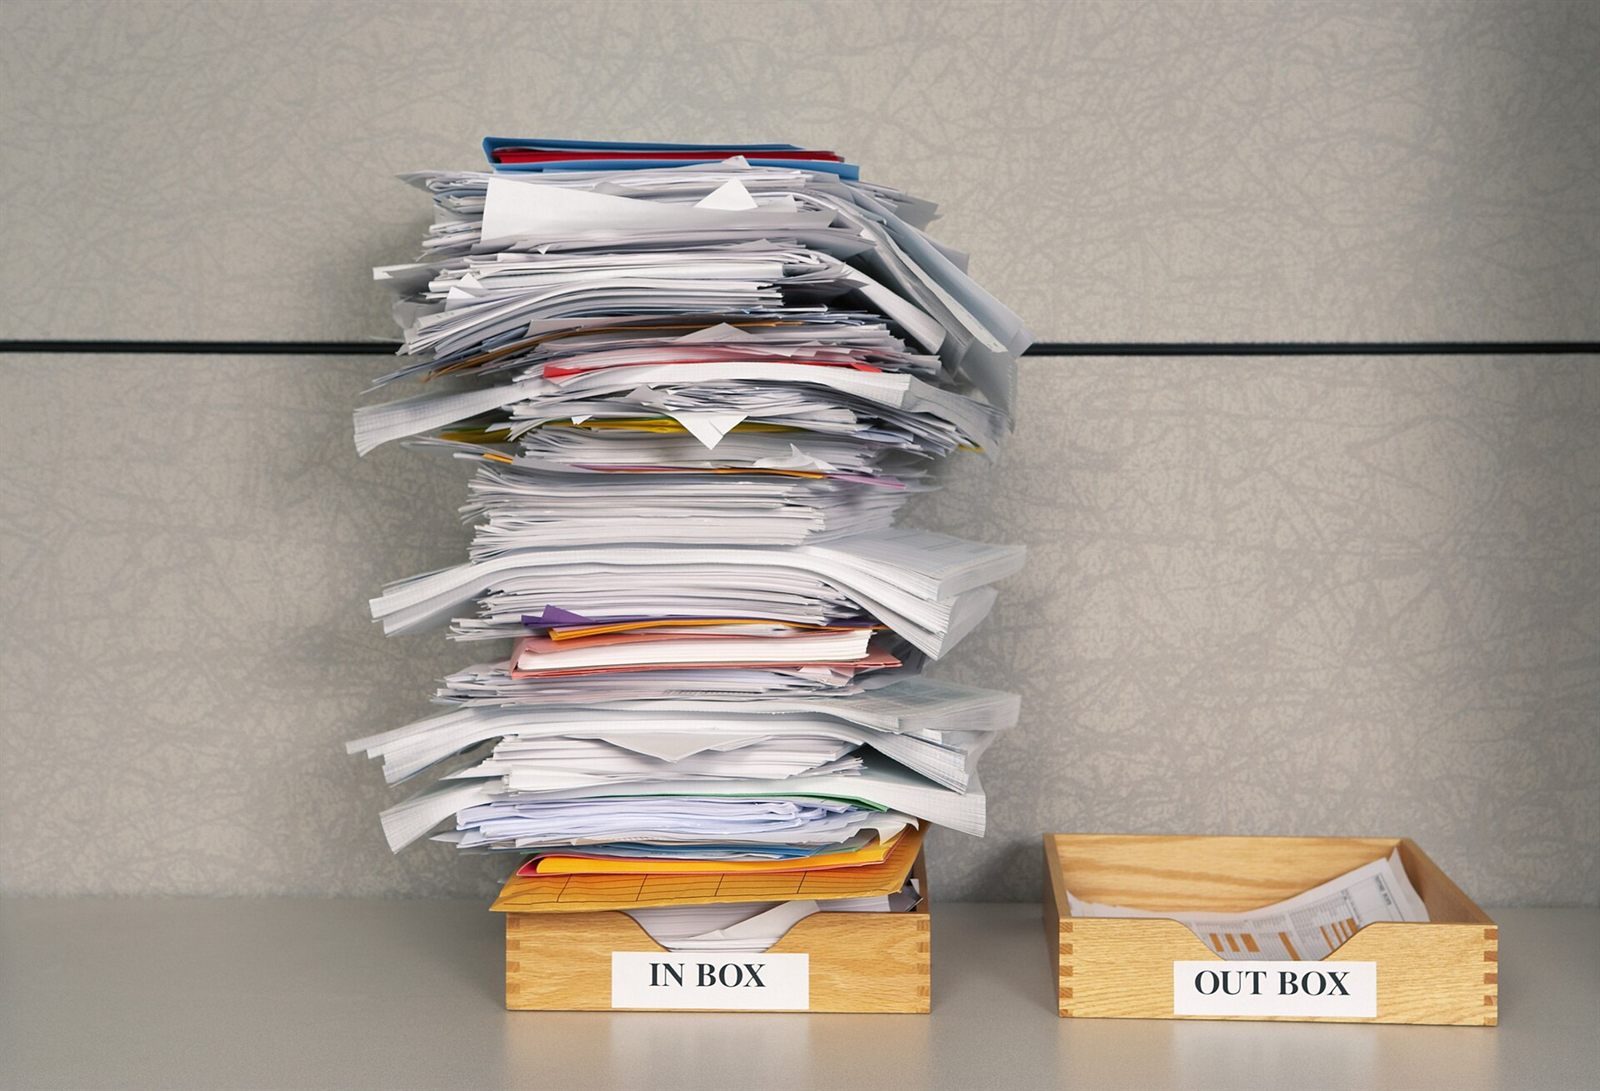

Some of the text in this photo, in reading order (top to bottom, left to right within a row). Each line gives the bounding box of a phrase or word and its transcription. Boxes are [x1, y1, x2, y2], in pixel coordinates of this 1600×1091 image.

[649, 963, 766, 988] IN BOX
[1195, 970, 1350, 996] OUT BOX
